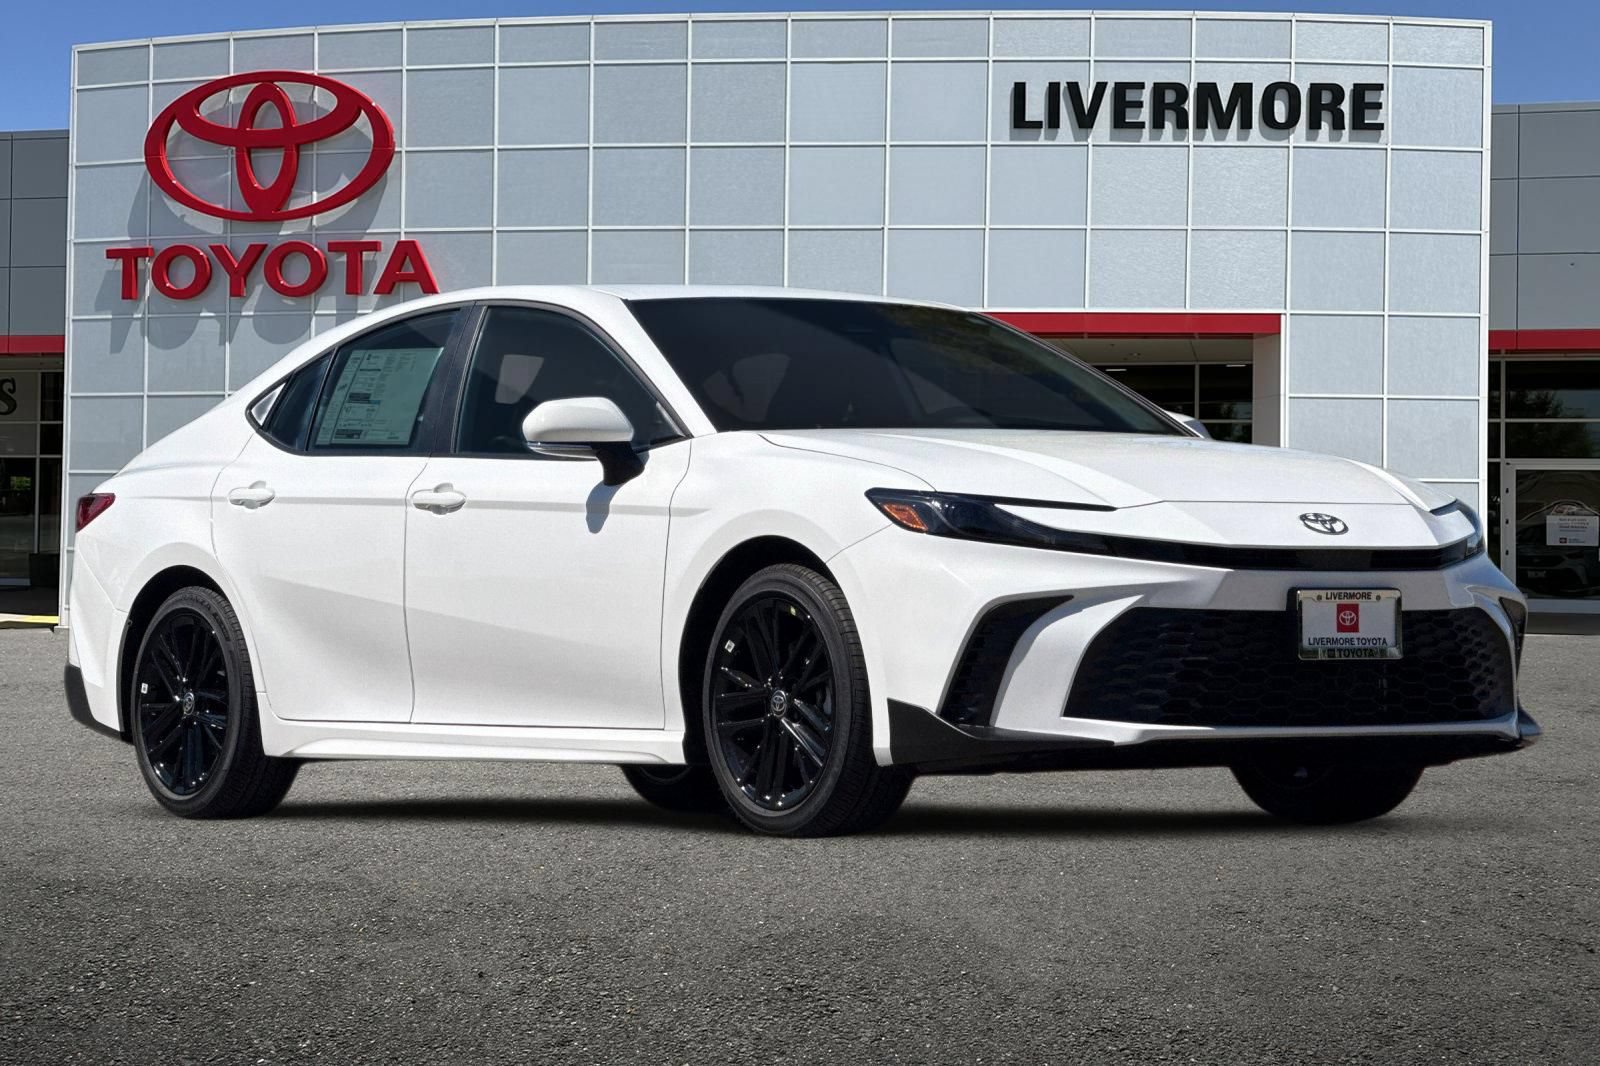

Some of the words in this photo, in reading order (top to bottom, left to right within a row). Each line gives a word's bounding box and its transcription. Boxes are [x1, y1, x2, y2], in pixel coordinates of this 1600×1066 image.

[1013, 81, 1385, 131] LIVERMORE
[105, 240, 440, 300] TOYOTA
[1325, 592, 1372, 600] LIVERMORE
[1308, 637, 1356, 646] LIVERMORE
[1357, 637, 1388, 646] TOYOTA
[1337, 648, 1375, 658] TOYOTA
